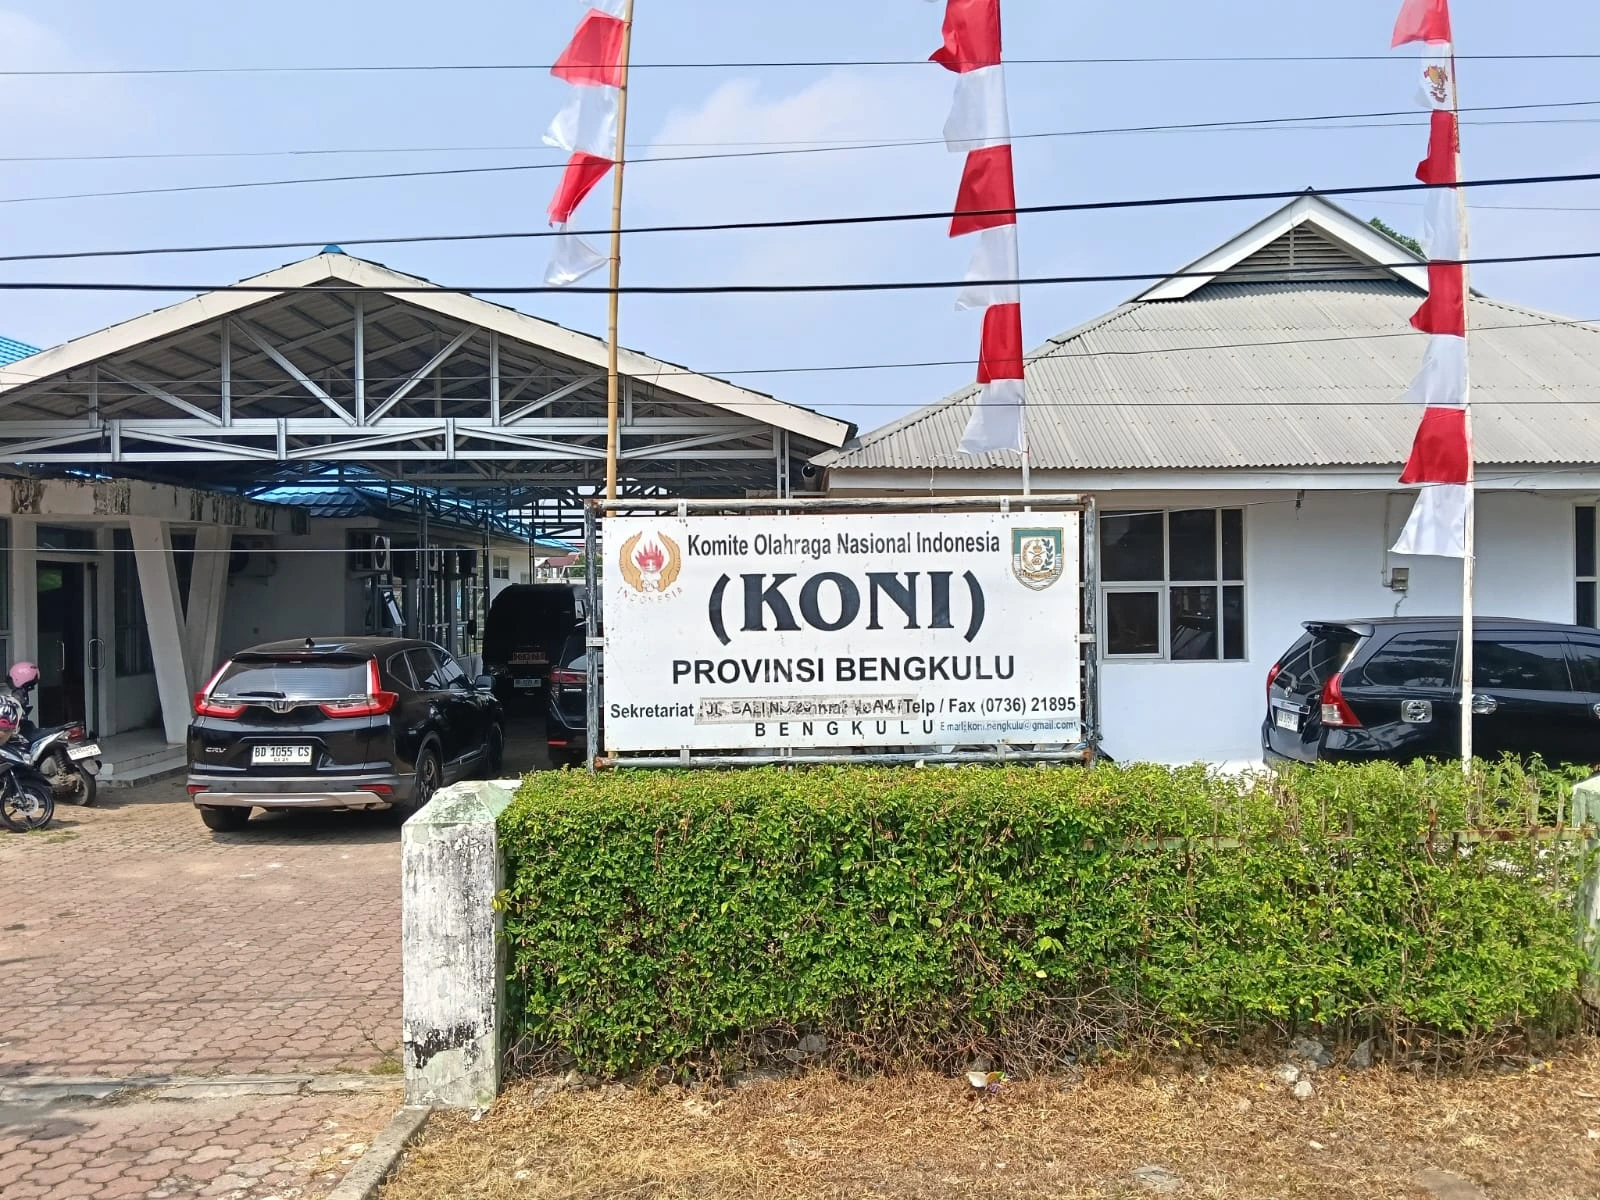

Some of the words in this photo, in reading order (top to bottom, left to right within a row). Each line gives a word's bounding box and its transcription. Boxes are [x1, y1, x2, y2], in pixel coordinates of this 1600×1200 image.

[688, 534, 749, 556] Komite
[755, 533, 832, 559] Olahraga
[837, 532, 911, 554] Nasional
[916, 531, 1001, 553] Indonesia
[708, 570, 986, 646] (KONI)
[672, 658, 825, 685] PROVINSI
[835, 655, 1016, 683] BENGKULU
[609, 702, 695, 719] Sekretariat
[903, 698, 935, 717] Telp
[939, 698, 944, 713] /
[949, 698, 976, 713] Fax
[980, 697, 1027, 716] (0736)
[1031, 696, 1077, 712] 21895
[255, 747, 266, 757] BD
[270, 747, 292, 757] 1055
[298, 747, 310, 757] CS
